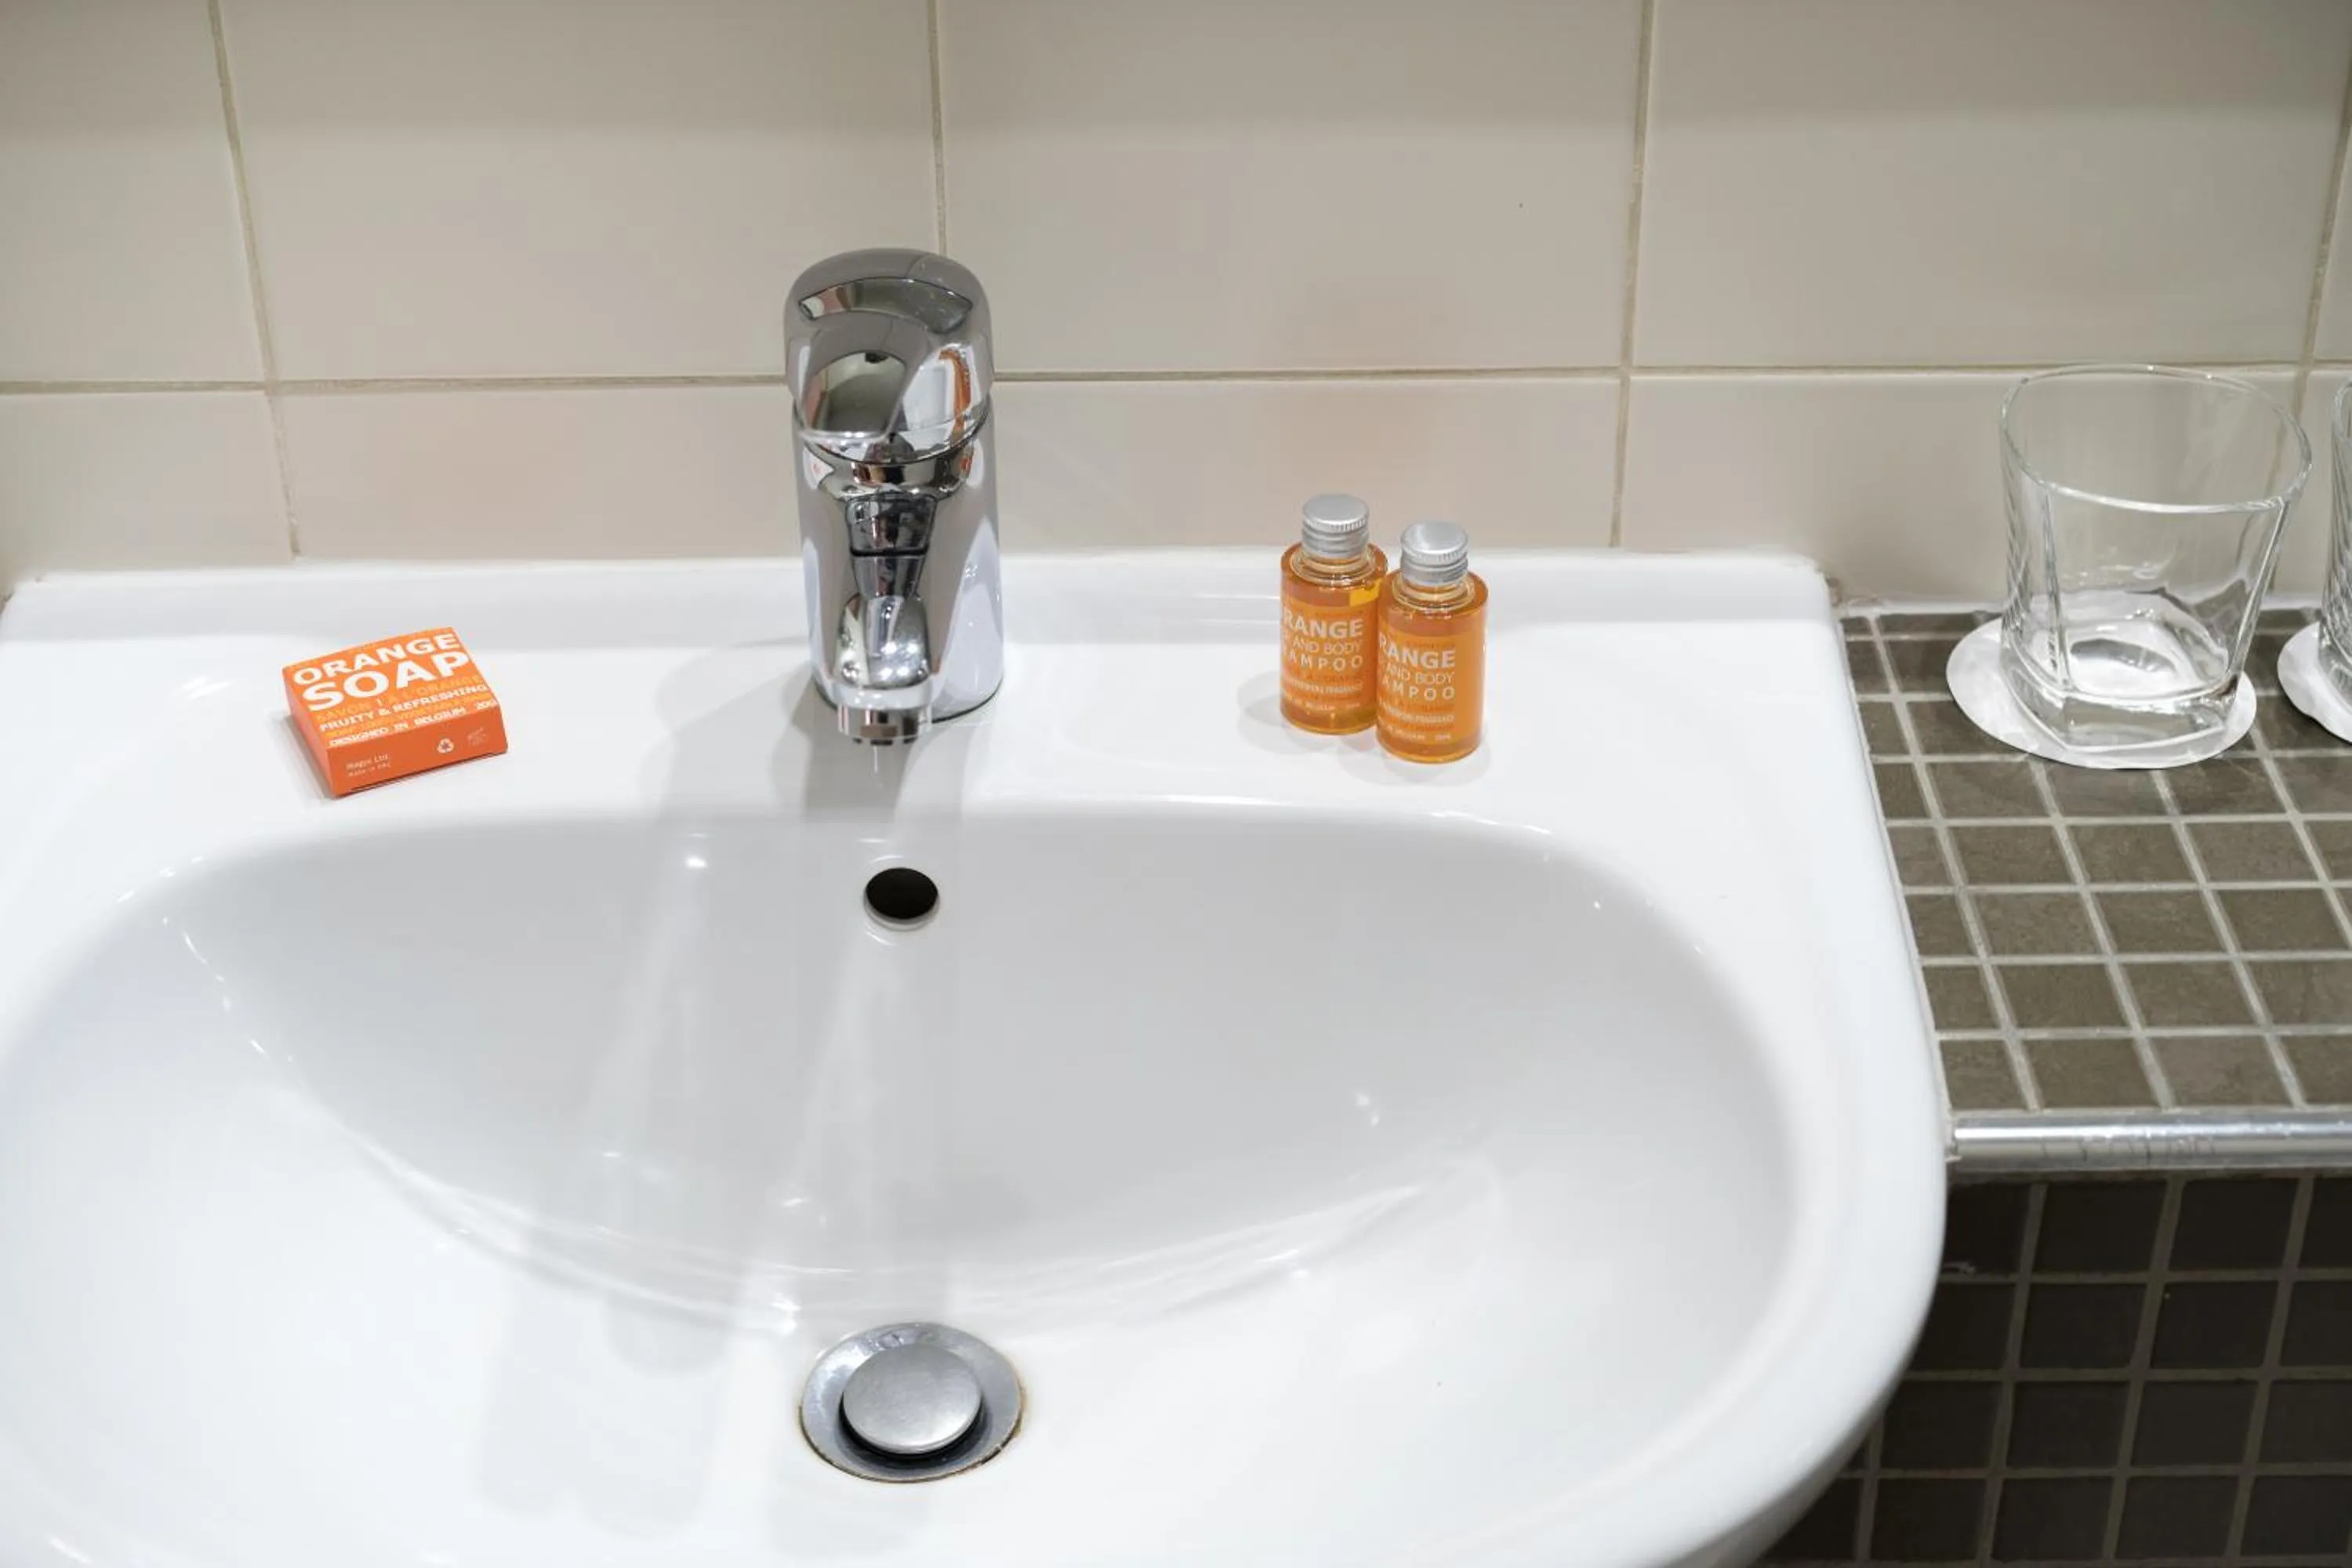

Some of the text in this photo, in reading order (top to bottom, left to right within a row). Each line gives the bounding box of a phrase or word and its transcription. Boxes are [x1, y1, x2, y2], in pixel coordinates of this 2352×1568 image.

[1283, 606, 1364, 639] RANGE
[293, 633, 461, 684] ORANGE
[1284, 648, 1363, 673] AMPOO
[1292, 634, 1363, 655] AND BODY
[1379, 632, 1455, 669] RANGE
[302, 652, 470, 711] SOAP
[1382, 674, 1455, 701] AMPOO
[1386, 662, 1454, 684] AND BODY
[319, 711, 374, 731] FRUITY
[392, 684, 490, 712] REFRESHING
